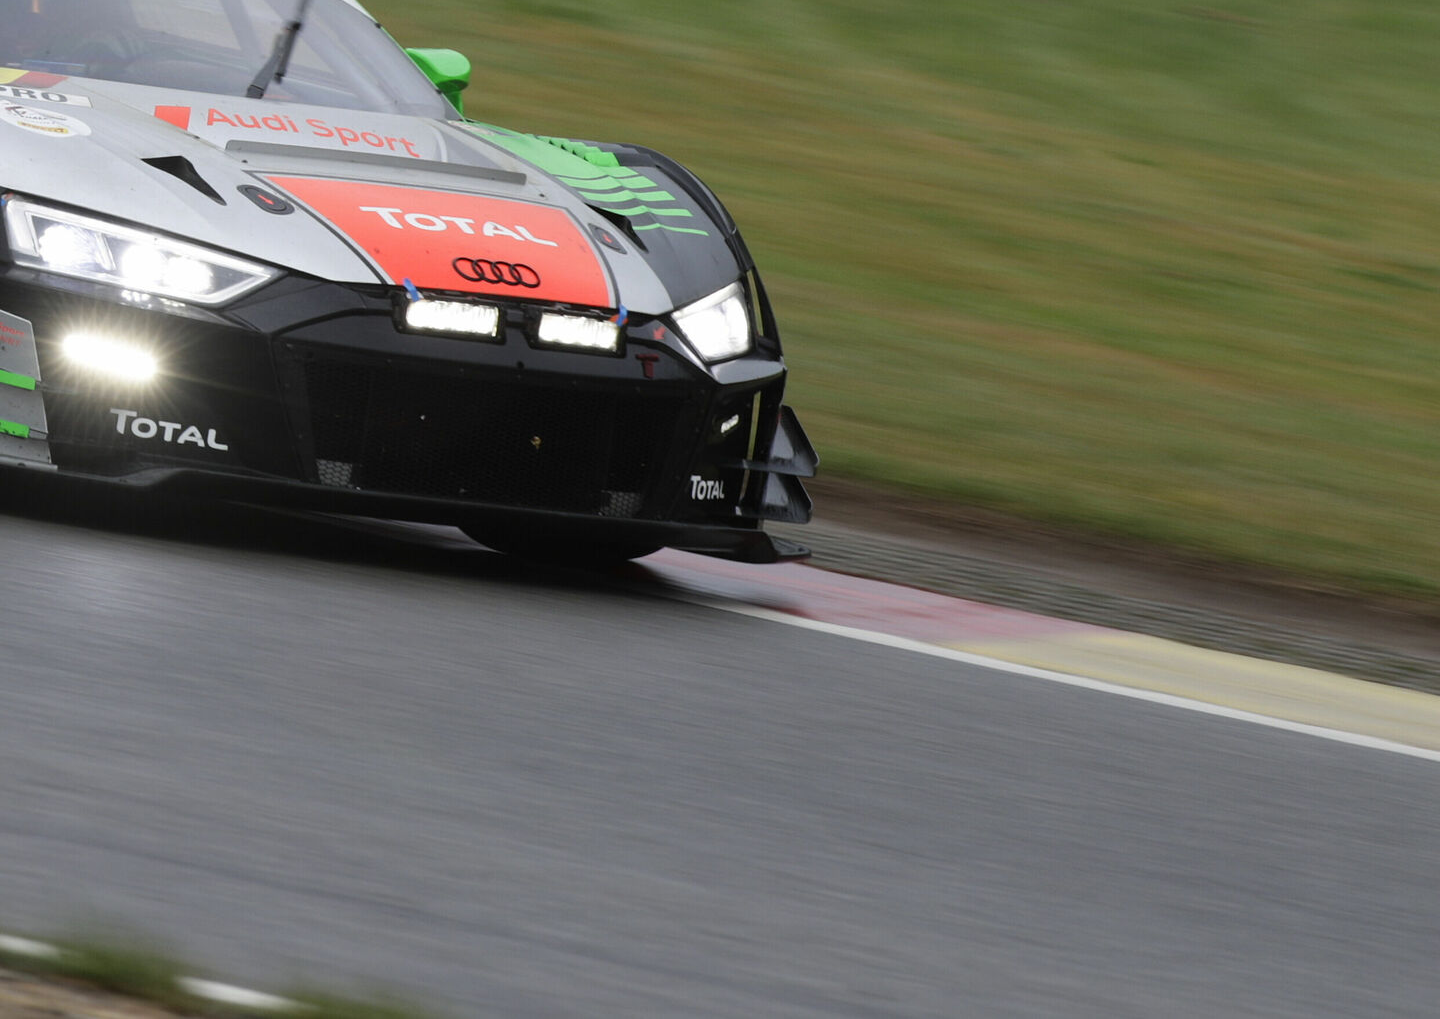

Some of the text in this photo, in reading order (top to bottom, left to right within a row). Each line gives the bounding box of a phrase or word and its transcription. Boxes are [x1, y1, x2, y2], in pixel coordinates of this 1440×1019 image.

[206, 107, 298, 134] Audi
[305, 118, 421, 159] Sport
[359, 205, 559, 248] TOTAL
[110, 407, 229, 451] TOTAL
[690, 474, 725, 500] TOTAL
